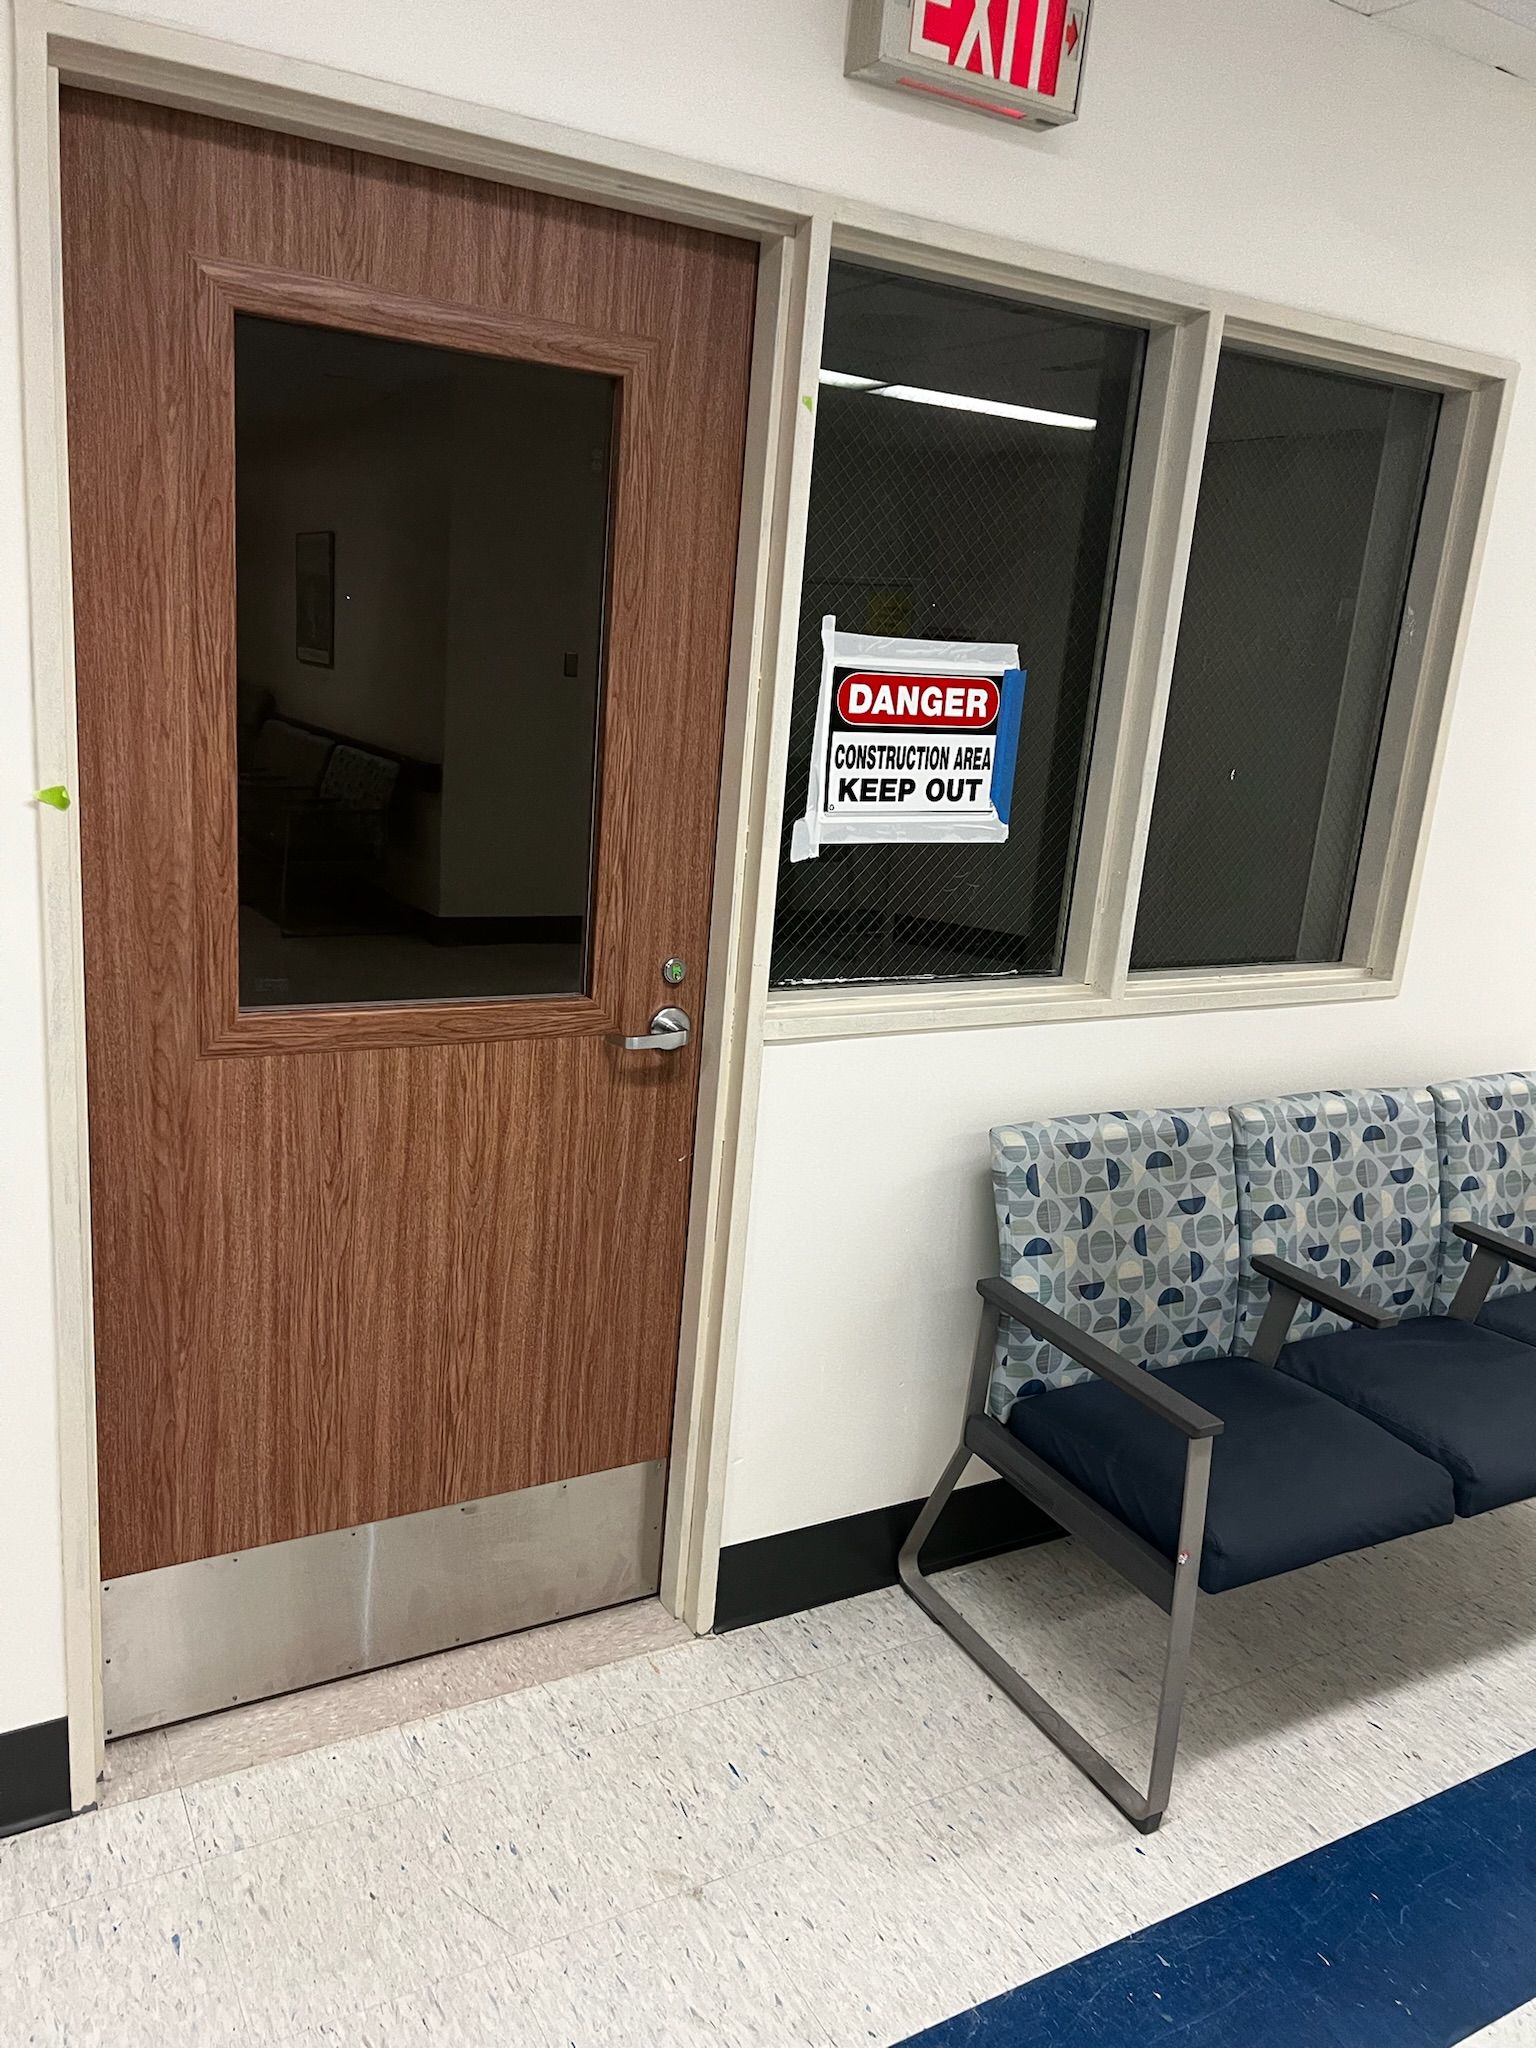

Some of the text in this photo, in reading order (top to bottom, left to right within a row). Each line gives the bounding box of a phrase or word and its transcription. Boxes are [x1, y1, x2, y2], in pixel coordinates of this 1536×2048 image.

[848, 683, 988, 718] DANGER
[835, 744, 991, 771] CONSTRUCTION AREA
[838, 778, 983, 802] KEEP OUT
